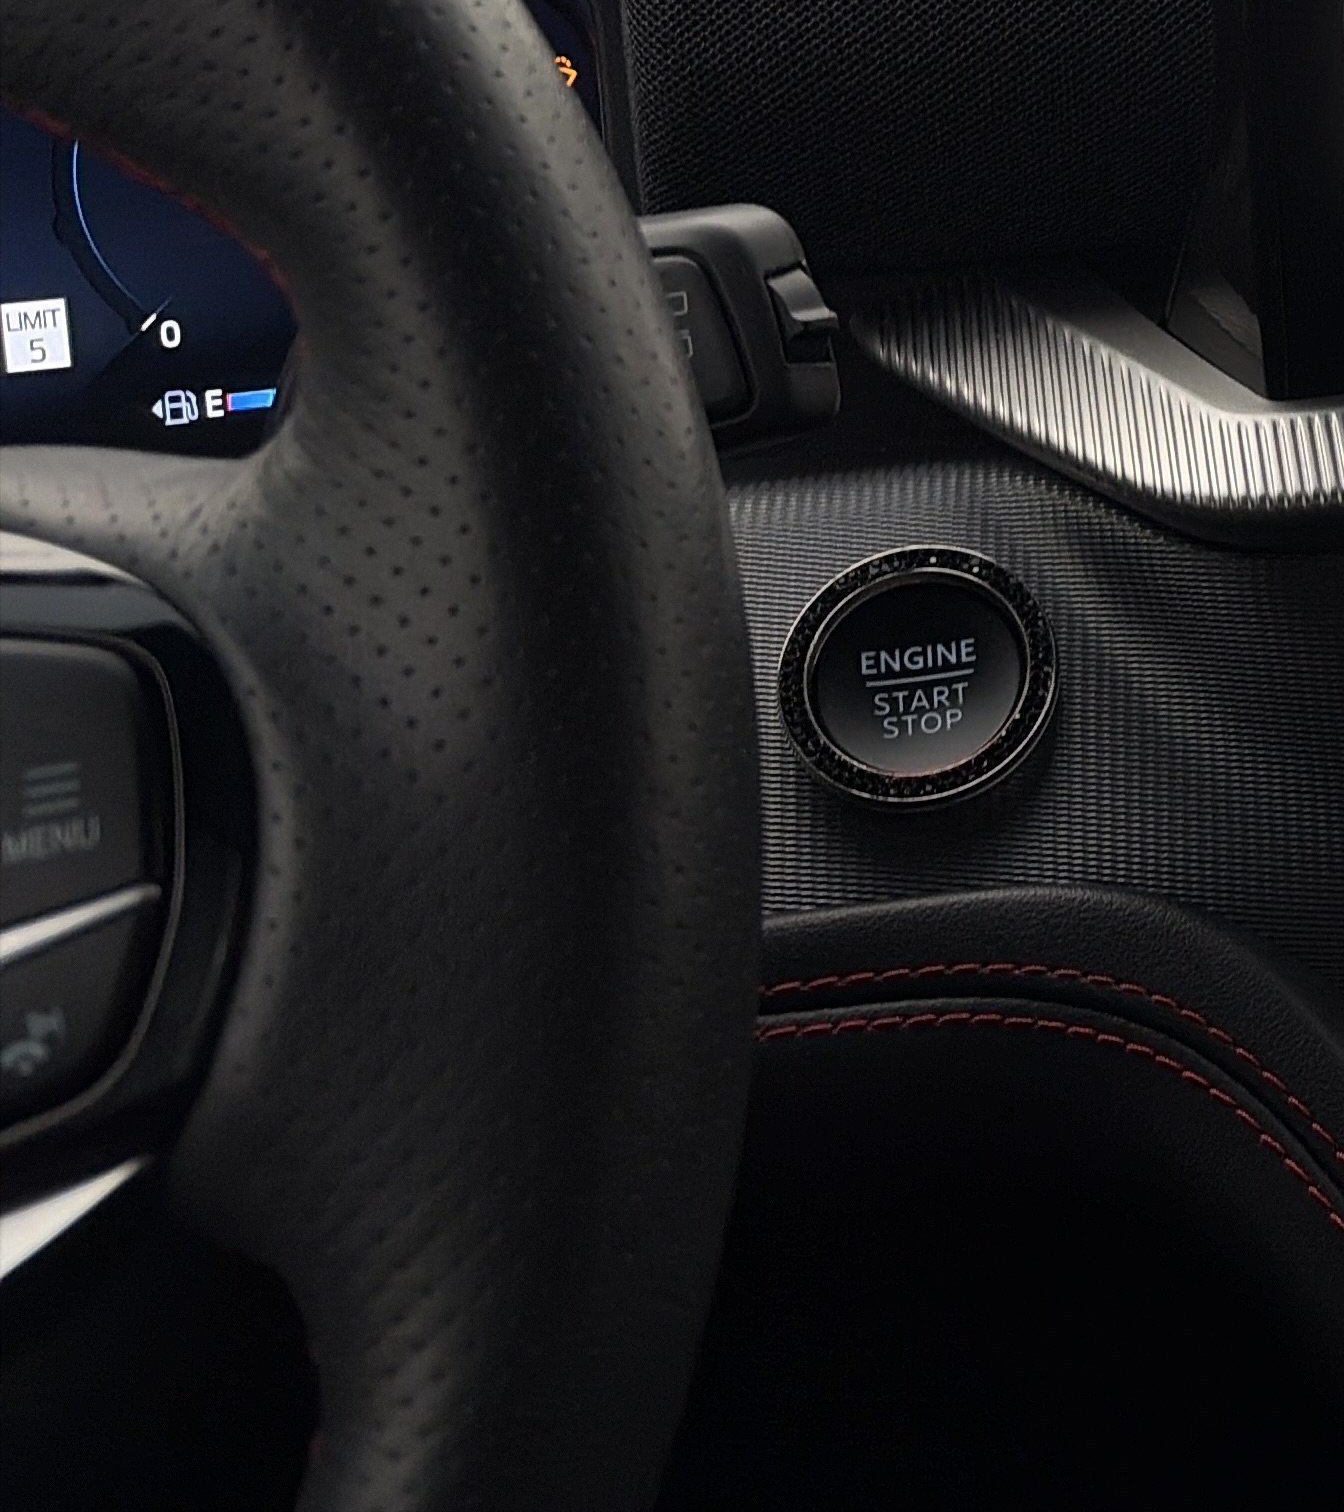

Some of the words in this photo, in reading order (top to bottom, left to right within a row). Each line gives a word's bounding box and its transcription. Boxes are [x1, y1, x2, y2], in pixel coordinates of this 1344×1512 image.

[5, 308, 61, 333] LIMIT
[29, 338, 46, 364] 5
[205, 389, 225, 418] E
[861, 638, 977, 676] ENGINE
[873, 682, 969, 717] START
[883, 708, 963, 739] STOP
[3, 815, 100, 865] MENU
